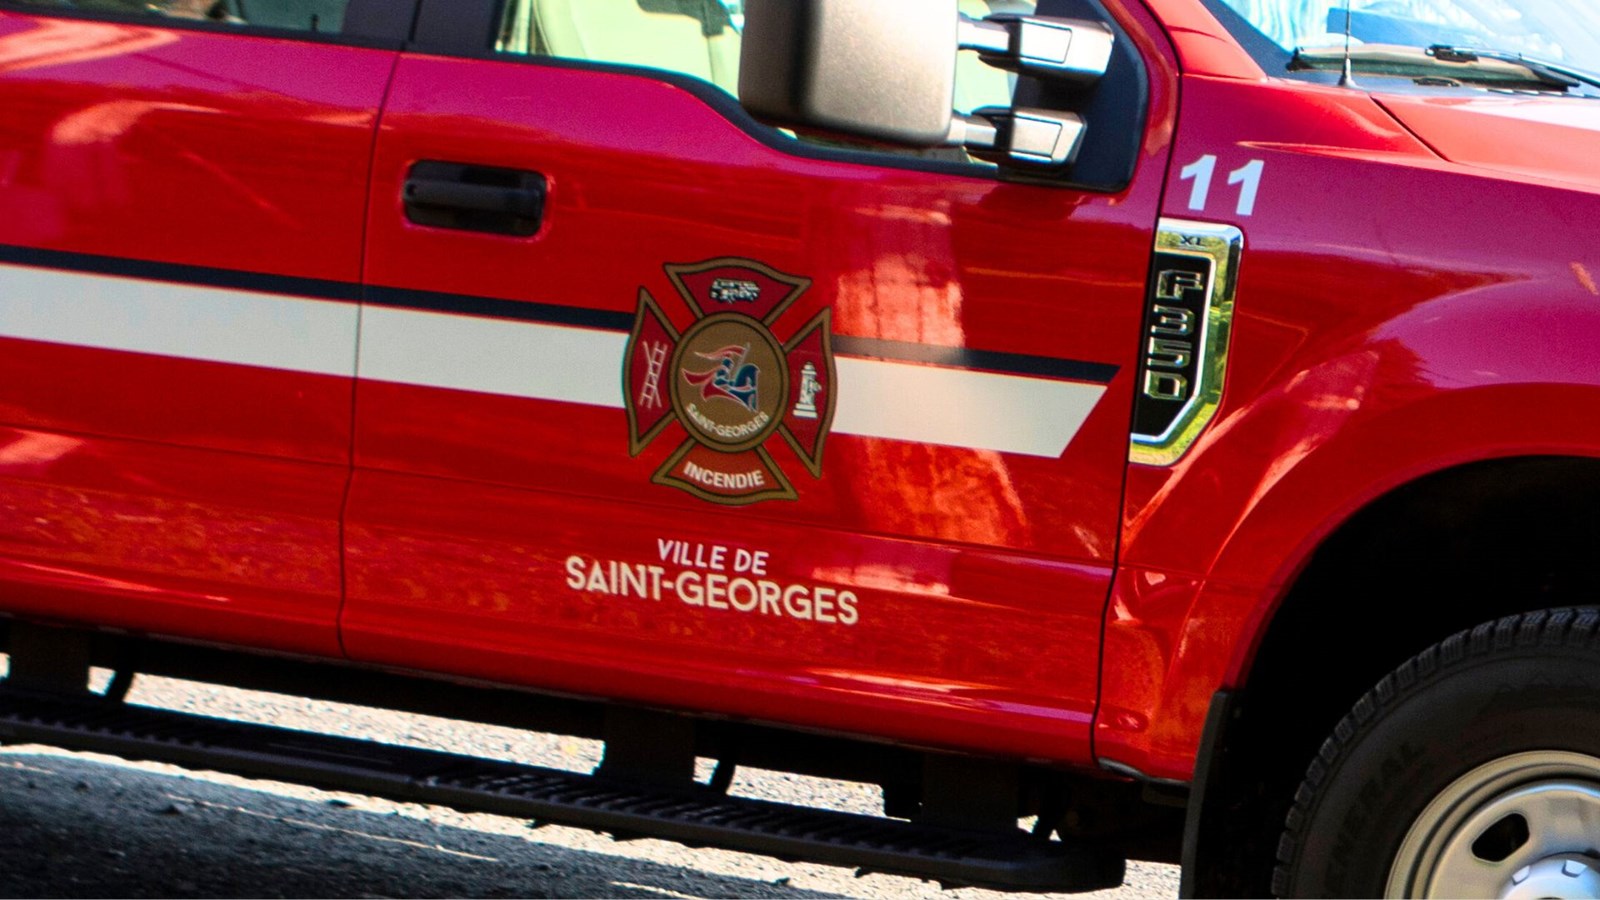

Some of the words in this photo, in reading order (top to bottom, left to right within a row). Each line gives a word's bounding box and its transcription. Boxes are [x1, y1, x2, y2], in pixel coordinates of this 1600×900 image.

[1180, 154, 1264, 216] 11
[1180, 234, 1206, 247] XL
[1144, 269, 1203, 401] F350
[686, 403, 770, 437] SAINT-GEORGES
[683, 461, 765, 489] INCENDIE
[657, 538, 728, 570] VILLE
[734, 548, 769, 576] DE
[565, 555, 859, 625] SAINT-GEORGES
